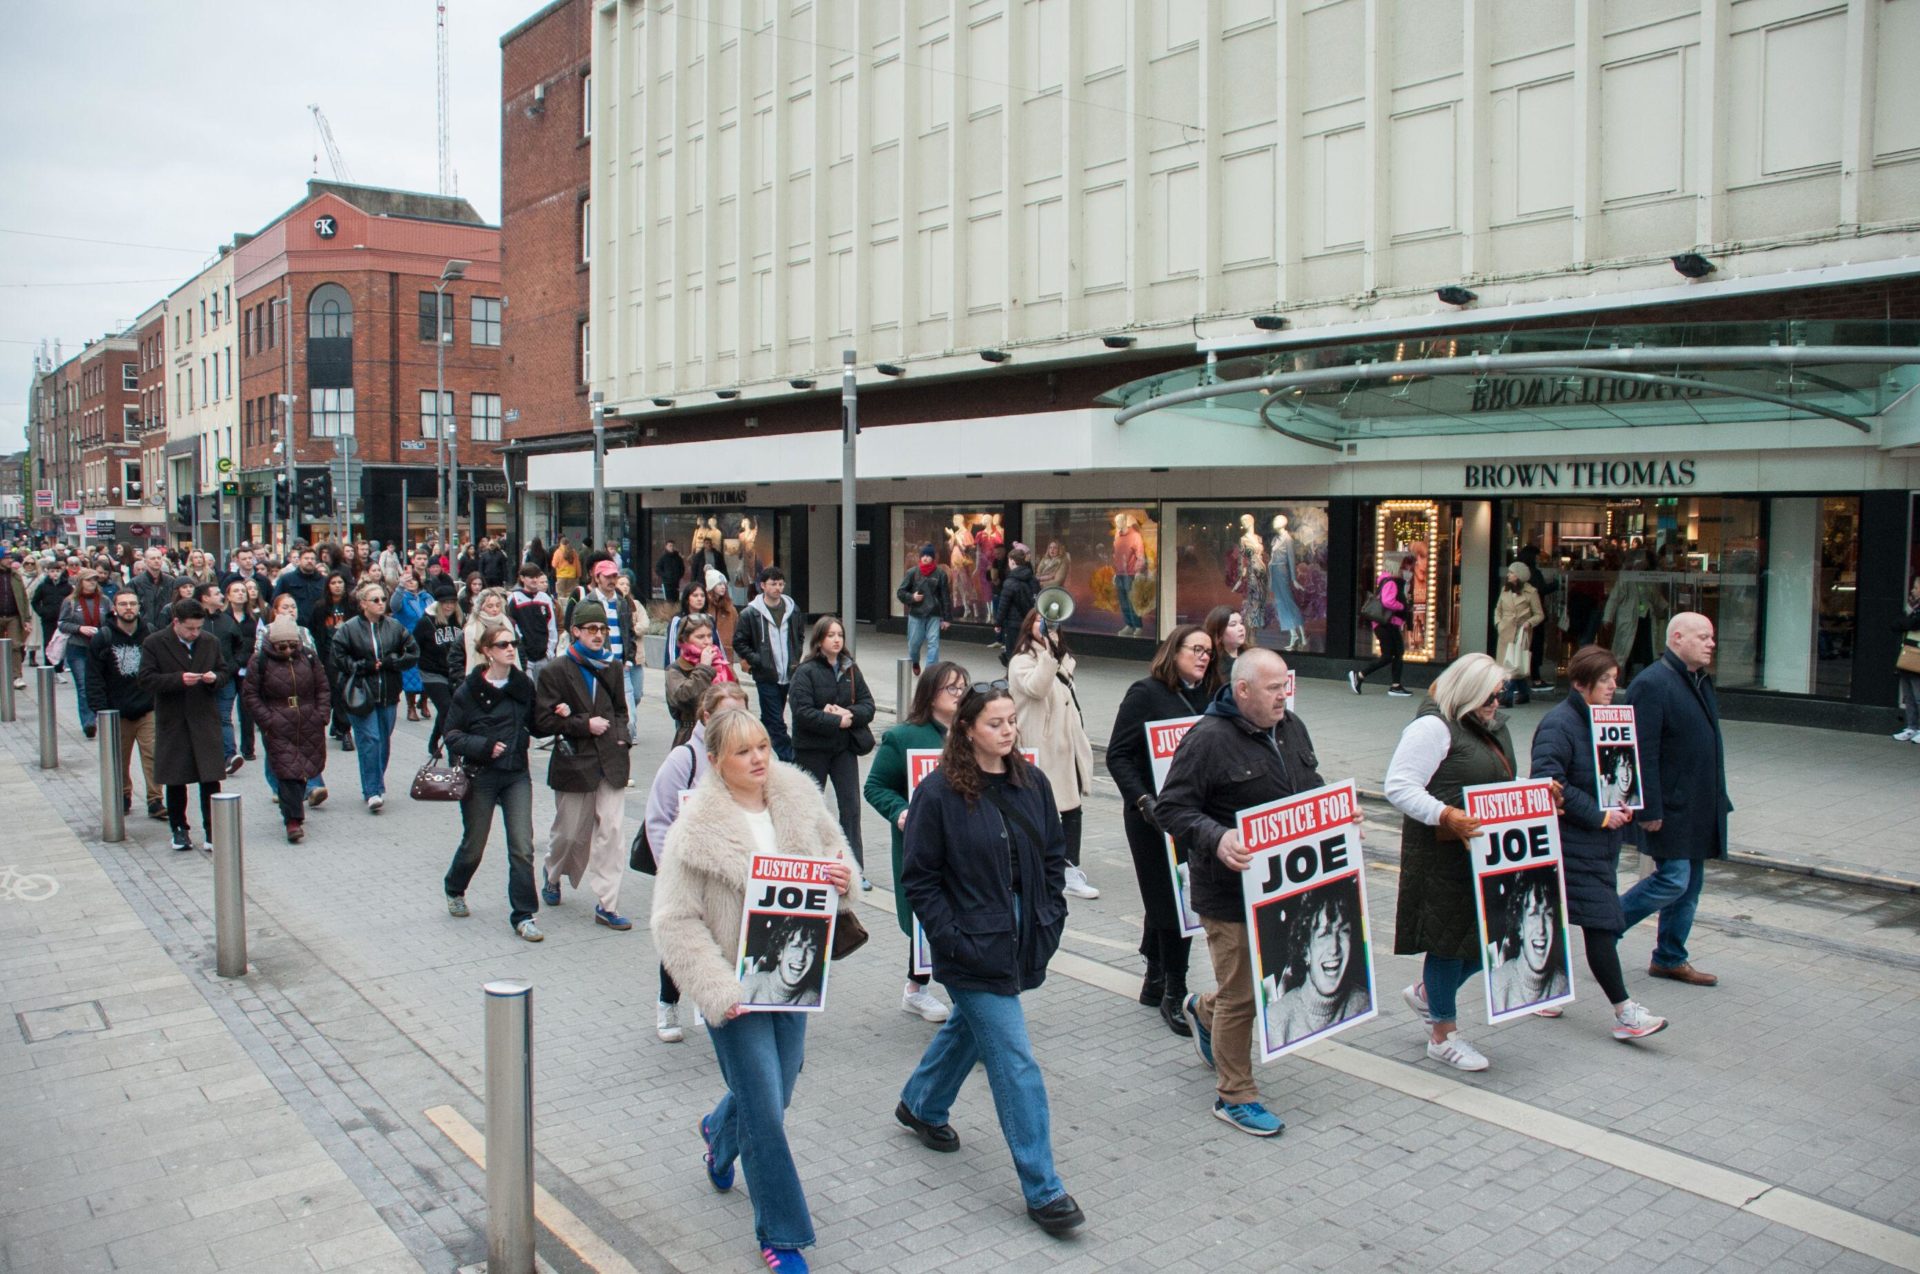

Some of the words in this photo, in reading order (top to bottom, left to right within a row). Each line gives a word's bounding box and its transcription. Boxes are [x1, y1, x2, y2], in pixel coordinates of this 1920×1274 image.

[314, 219, 334, 235] K
[1465, 462, 1561, 488] BROWN
[1567, 459, 1696, 488] THOMAS
[709, 490, 747, 504] THOMAS
[1594, 708, 1618, 721] JUSTICE
[1619, 709, 1632, 721] FOR
[1600, 726, 1631, 741] JOE
[1473, 791, 1524, 820] JUSTICE
[1525, 787, 1551, 814] FOR
[1249, 802, 1316, 848] JUSTICE
[1319, 792, 1351, 825] FOR
[1485, 824, 1550, 865] JOE
[756, 858, 809, 880] JUSTICE
[1262, 833, 1349, 894] JOE
[758, 885, 828, 911] JOE
